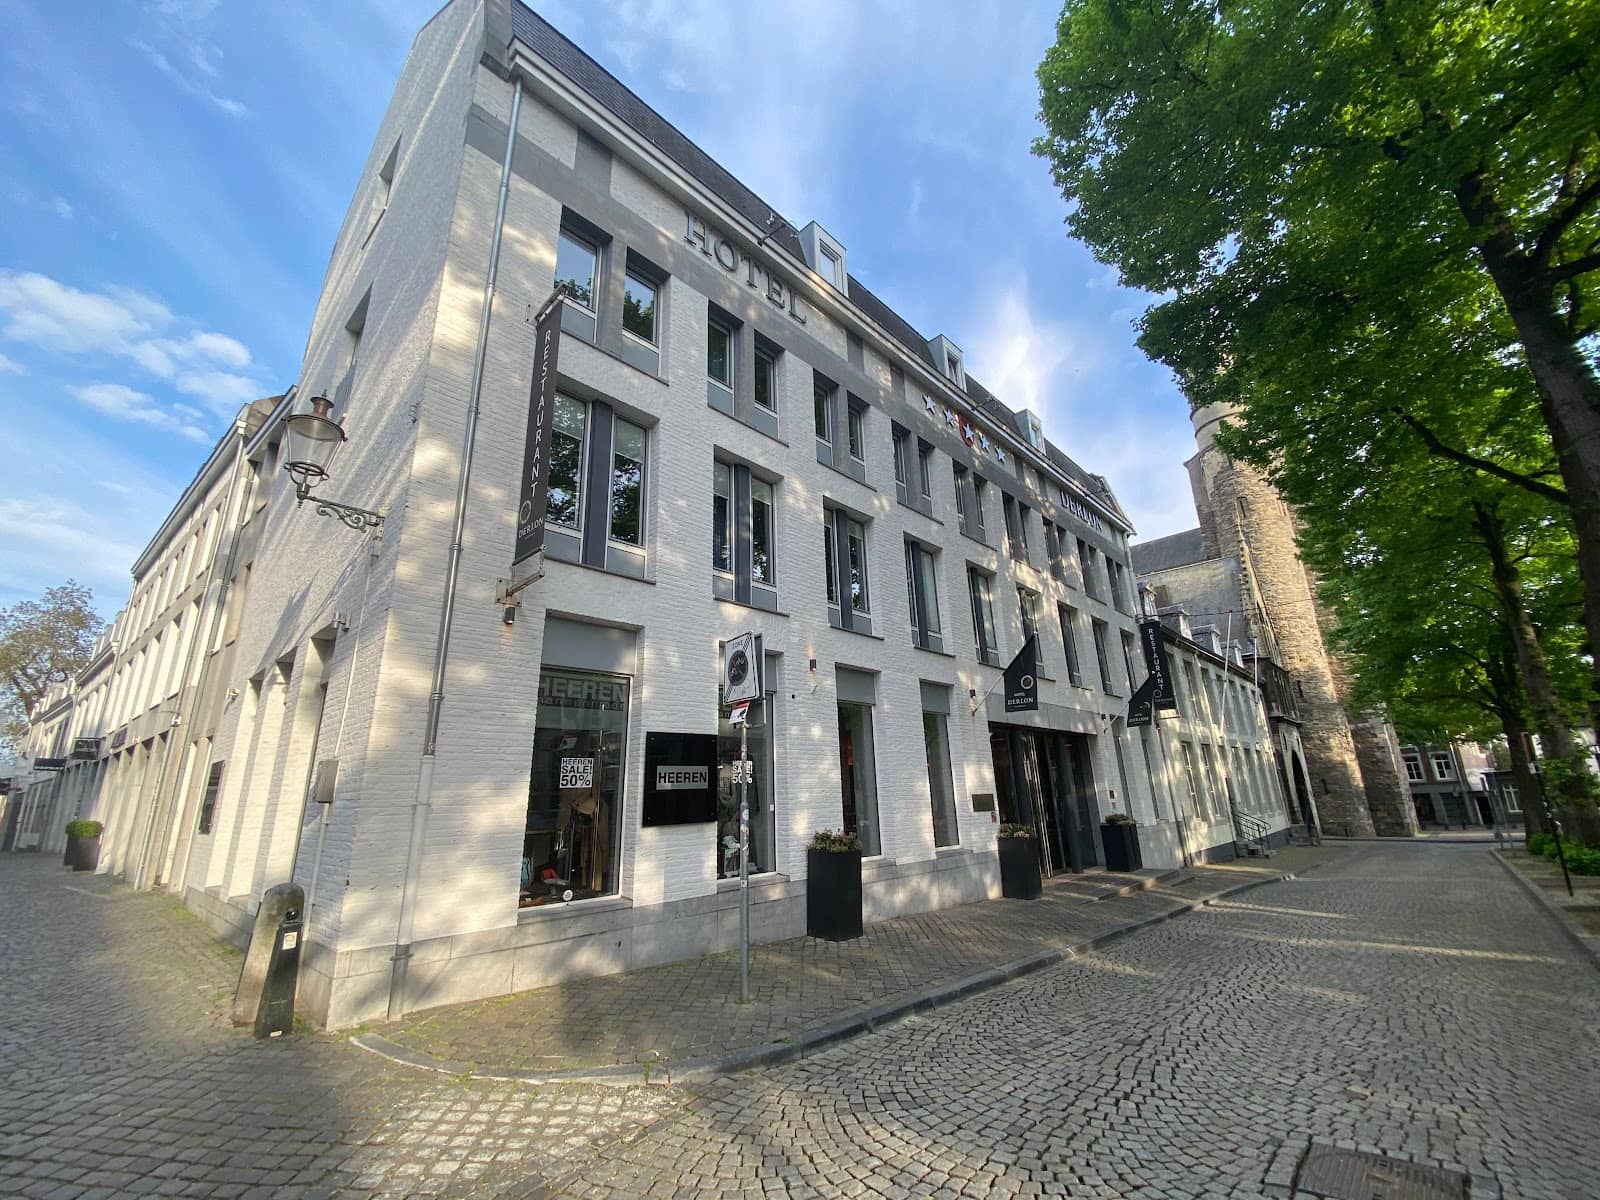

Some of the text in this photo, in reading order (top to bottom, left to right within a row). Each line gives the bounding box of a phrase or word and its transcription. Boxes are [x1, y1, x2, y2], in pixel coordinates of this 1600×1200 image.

[684, 209, 807, 325] HOTEL
[530, 329, 551, 498] RESTAURANT
[1060, 490, 1104, 531] DERLON
[518, 516, 544, 539] DERLON
[1148, 628, 1165, 691] RESTAURANT
[539, 676, 628, 702] HEEREN
[1007, 697, 1034, 706] DERLON
[560, 774, 591, 787] 50%
[561, 765, 593, 775] SALE!
[658, 771, 708, 785] HEEREN
